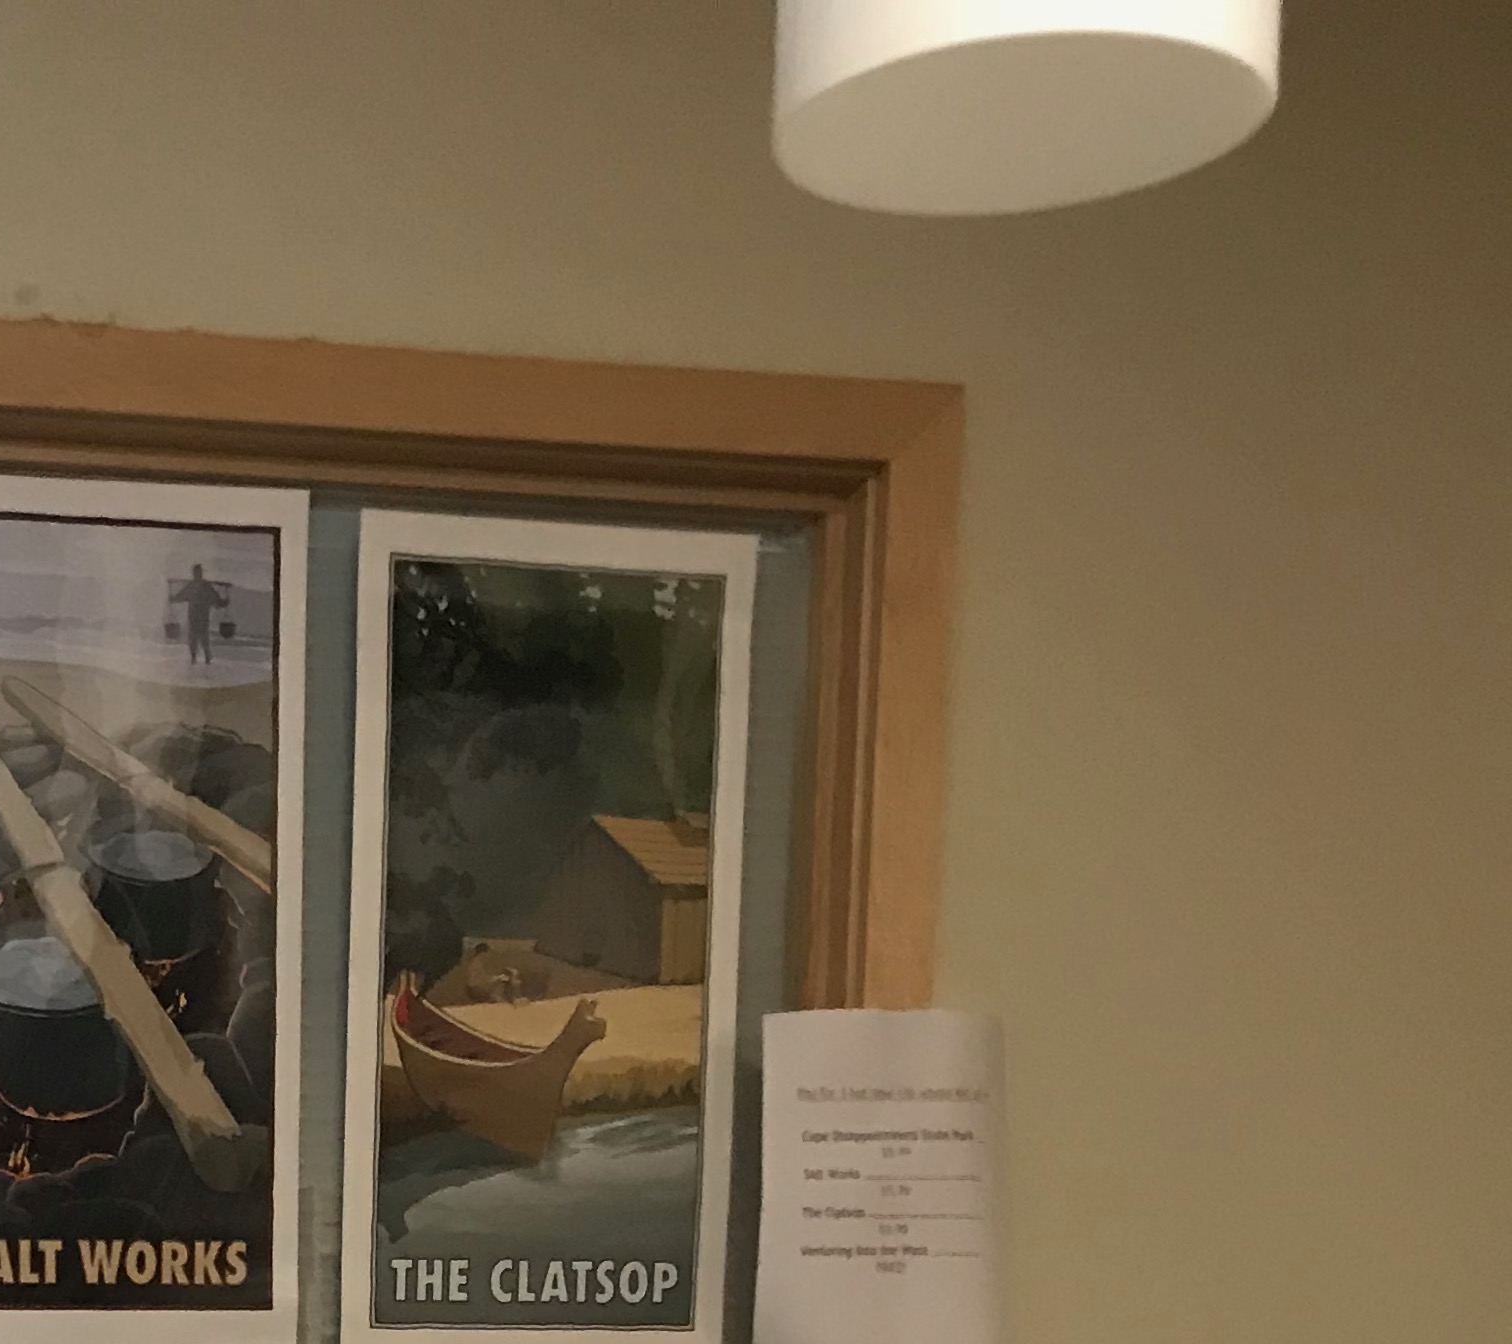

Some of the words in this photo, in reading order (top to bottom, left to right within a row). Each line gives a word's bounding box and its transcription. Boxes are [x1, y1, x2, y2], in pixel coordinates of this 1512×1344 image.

[78, 1239, 248, 1285] WORKS
[391, 1258, 469, 1301] THE
[490, 1259, 678, 1303] CLATSOP
